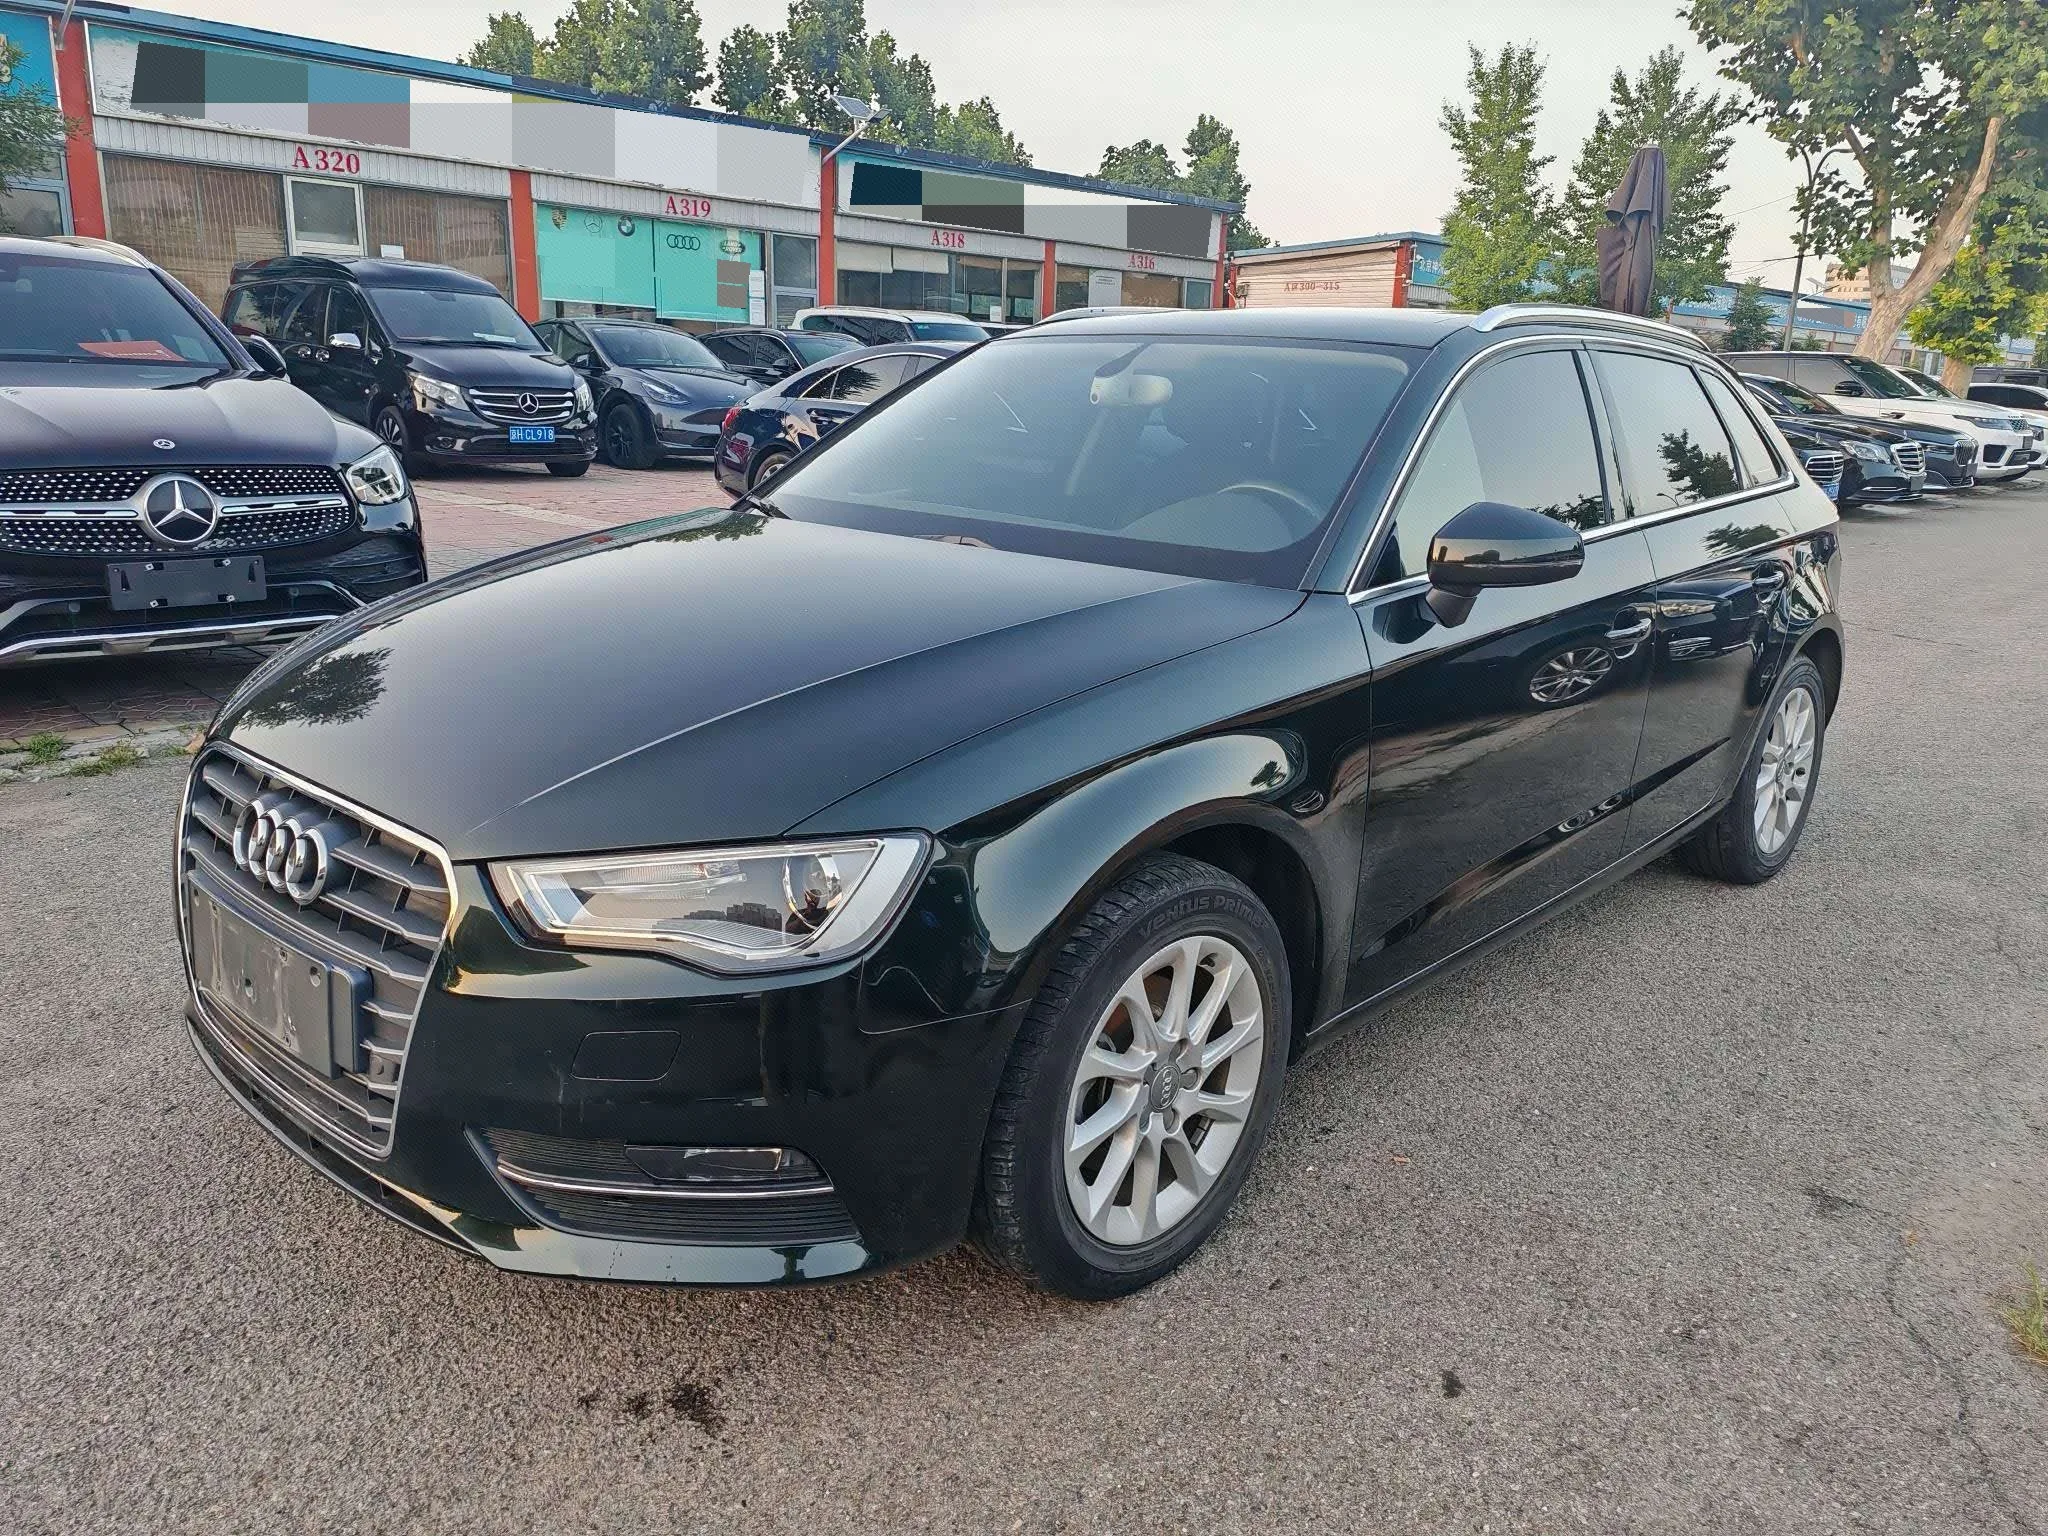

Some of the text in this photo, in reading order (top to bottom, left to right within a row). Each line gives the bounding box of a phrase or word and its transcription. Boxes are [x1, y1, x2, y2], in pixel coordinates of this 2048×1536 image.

[291, 146, 360, 174] A320
[665, 196, 711, 217] A319
[931, 230, 965, 248] A318
[1128, 254, 1155, 269] A316
